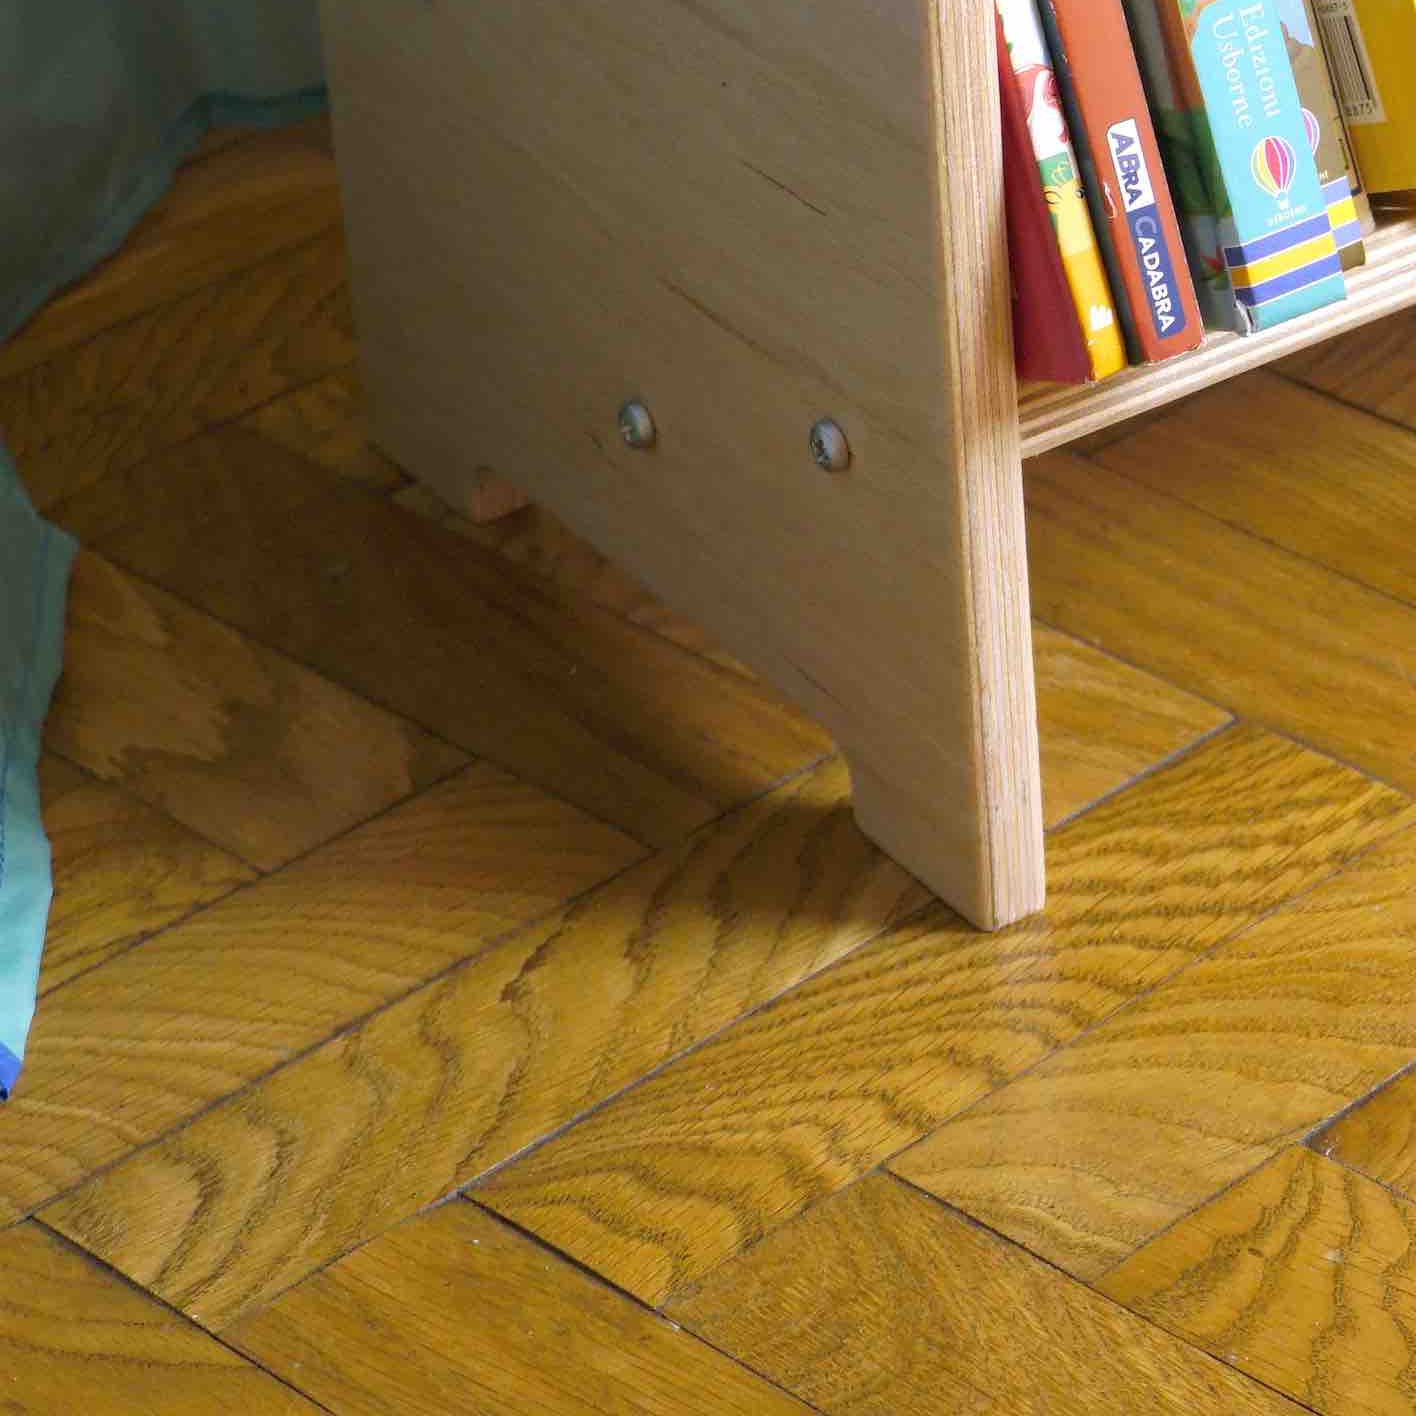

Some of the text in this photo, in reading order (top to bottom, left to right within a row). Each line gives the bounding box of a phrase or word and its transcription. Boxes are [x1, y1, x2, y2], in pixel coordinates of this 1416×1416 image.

[1212, 12, 1255, 129] Usborne
[1239, 3, 1281, 119] Edizioni
[1110, 130, 1143, 206] ABRA
[1134, 216, 1176, 333] CADABRA
